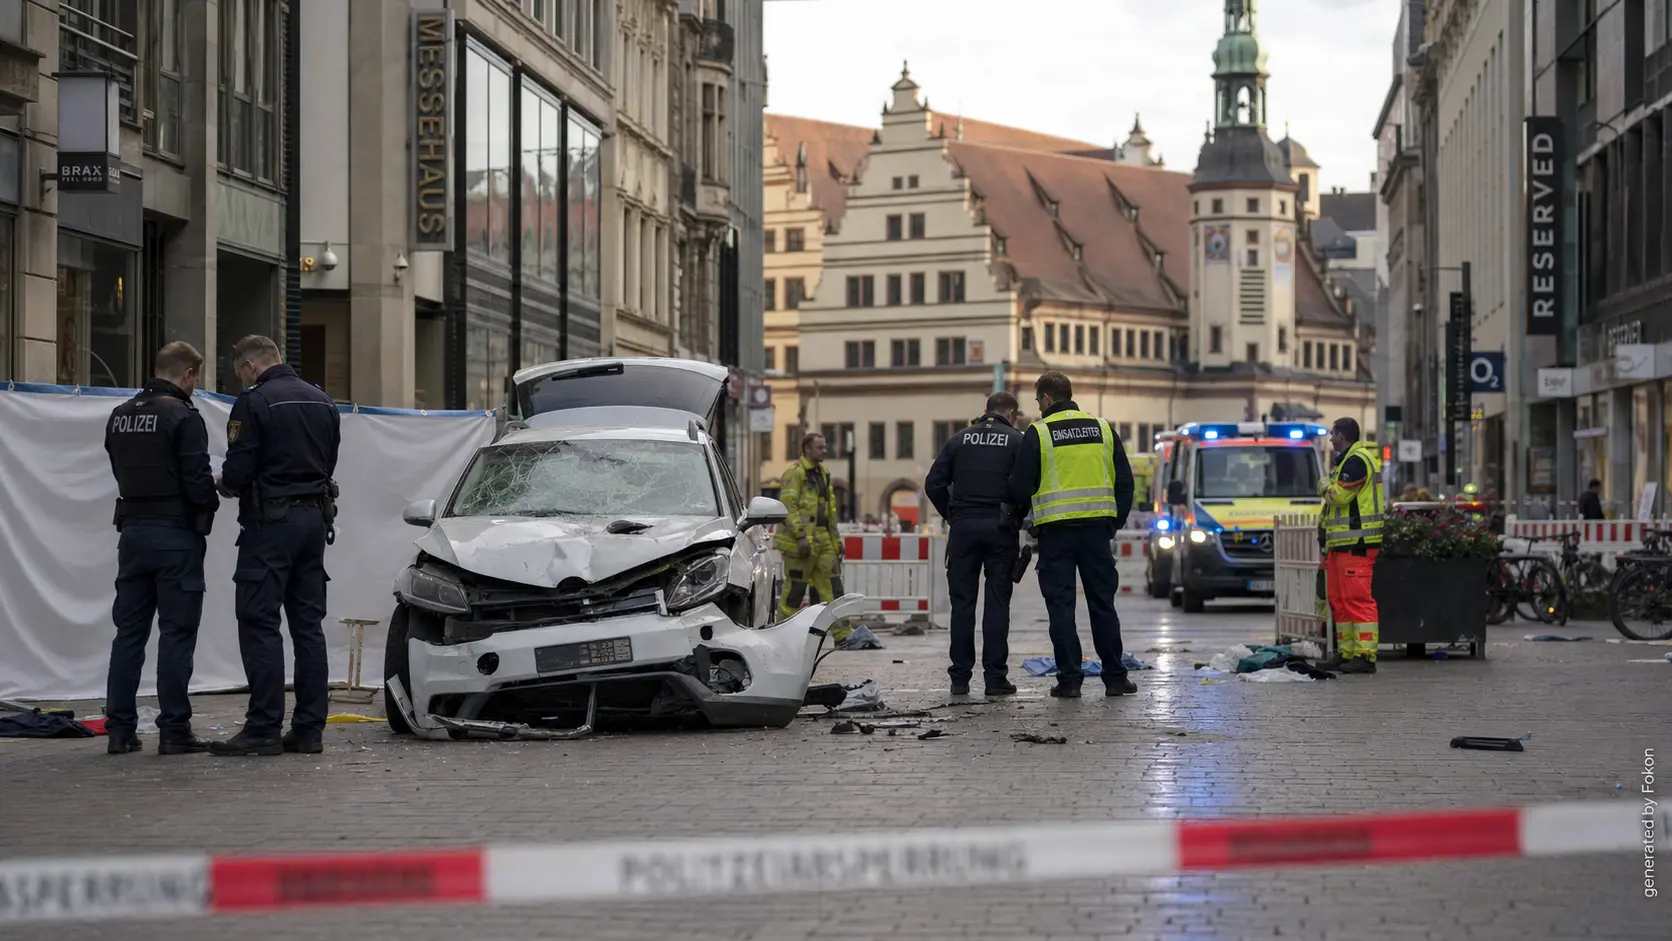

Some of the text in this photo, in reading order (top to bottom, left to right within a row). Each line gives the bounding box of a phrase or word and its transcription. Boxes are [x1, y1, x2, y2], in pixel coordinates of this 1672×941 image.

[418, 16, 445, 234] MESSEHAUS
[62, 165, 102, 176] BRAX
[1532, 133, 1554, 317] RESERVED
[1471, 357, 1499, 388] O2
[112, 415, 158, 432] POLIZEI
[963, 432, 1009, 446] POLIZEI
